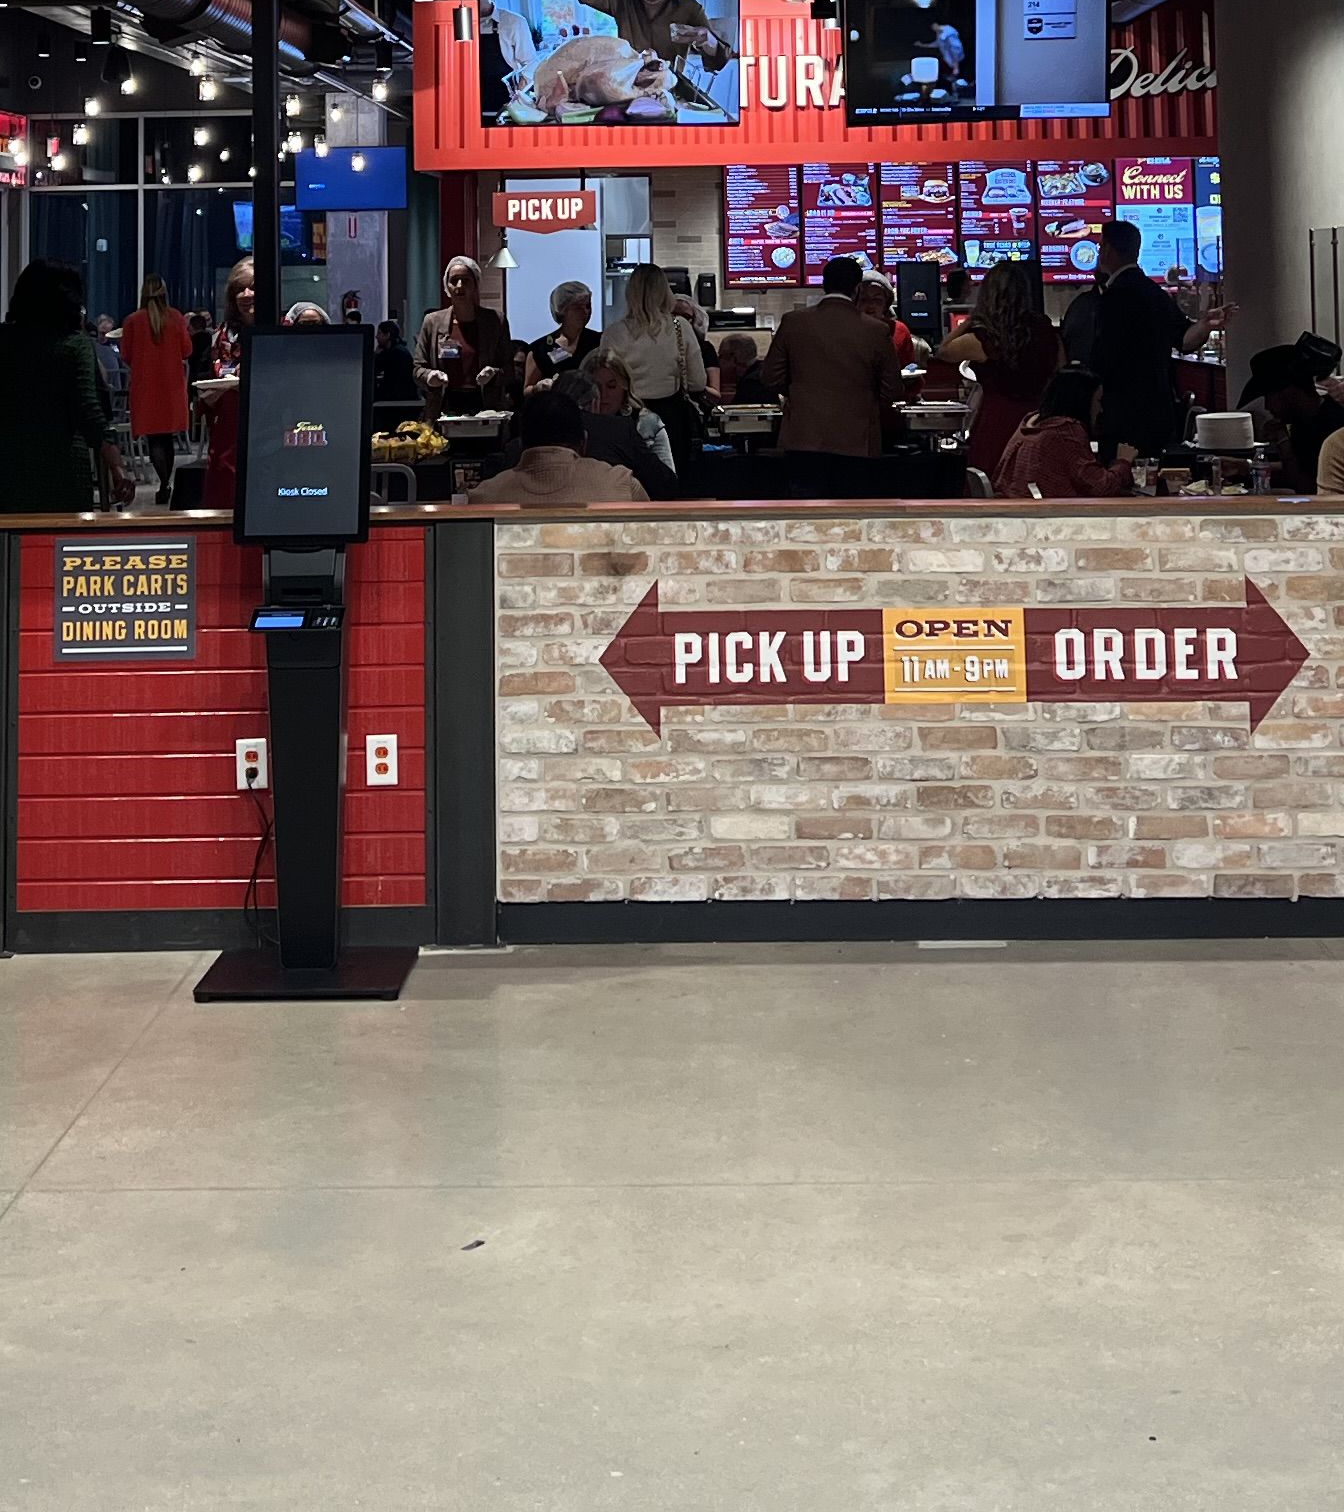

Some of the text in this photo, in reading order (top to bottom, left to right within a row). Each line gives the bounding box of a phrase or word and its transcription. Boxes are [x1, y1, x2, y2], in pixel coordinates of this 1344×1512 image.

[1121, 165, 1188, 185] Connect
[1121, 184, 1184, 200] WITH US
[507, 197, 584, 223] PICK UP
[278, 487, 328, 497] Kiosk Closed
[63, 554, 188, 571] PLEASE
[62, 574, 188, 597] PARK CARTS
[78, 602, 171, 615] OUTSIDE
[62, 619, 188, 641] DINING ROOM
[893, 618, 1013, 639] OPEN
[673, 629, 867, 684] PICK UP
[1055, 628, 1239, 681] ORDER
